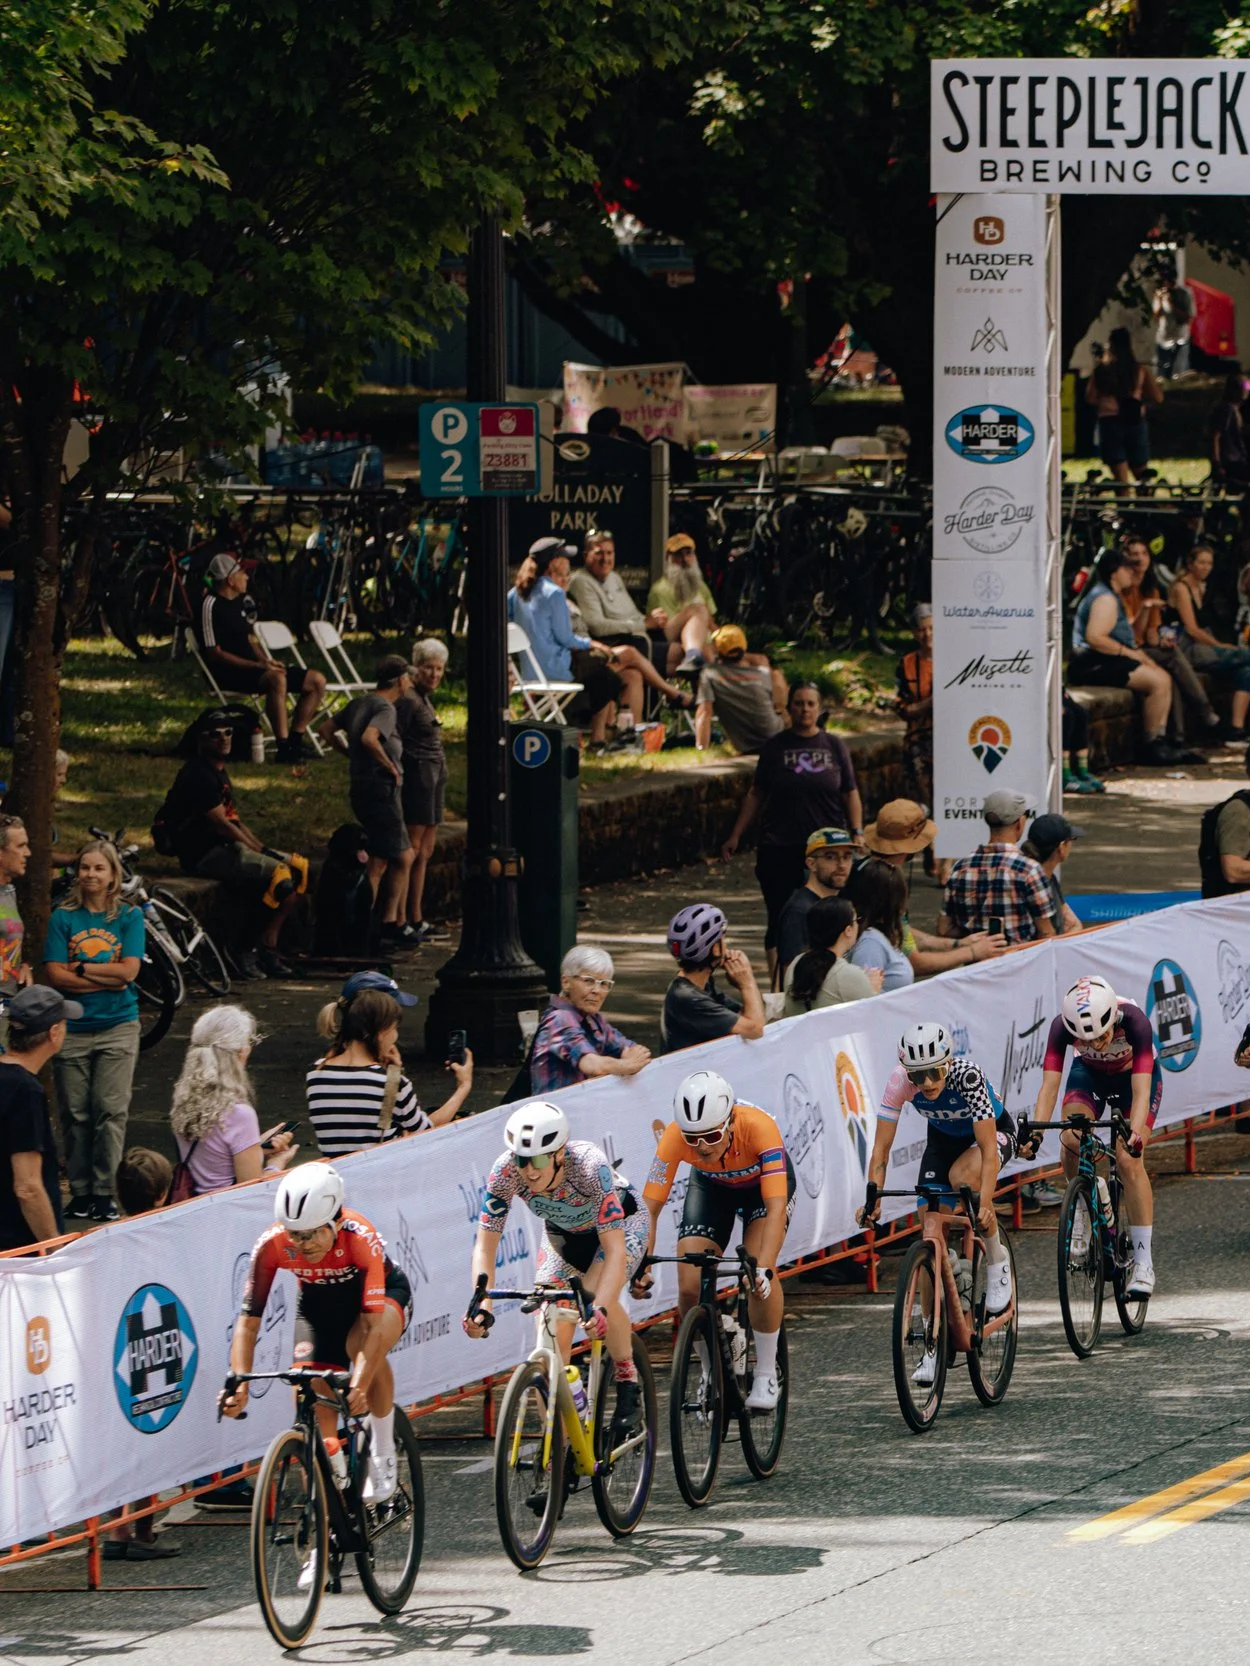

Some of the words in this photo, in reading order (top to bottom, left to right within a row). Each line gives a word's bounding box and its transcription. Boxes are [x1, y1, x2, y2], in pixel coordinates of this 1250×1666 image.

[942, 70, 1249, 155] STEEPLEJACK
[980, 159, 1152, 182] BREWING
[945, 253, 1034, 266] HARDER
[969, 269, 1009, 281] DAY
[943, 366, 981, 377] MODERN
[983, 366, 1036, 377] ADVENTURE
[442, 412, 460, 439] P
[961, 424, 1017, 438] HARDER
[440, 449, 464, 483] 2
[551, 510, 599, 530] PARK
[943, 508, 1000, 535] Harder
[1000, 503, 1036, 526] Day
[942, 605, 981, 618] Water
[981, 605, 1035, 618] Avenue
[943, 649, 1034, 690] Musette
[523, 734, 539, 762] P
[944, 808, 985, 820] EVENT
[128, 1327, 182, 1373] HARDER
[3, 1382, 77, 1425] HARDER
[25, 1418, 58, 1450] DAY
